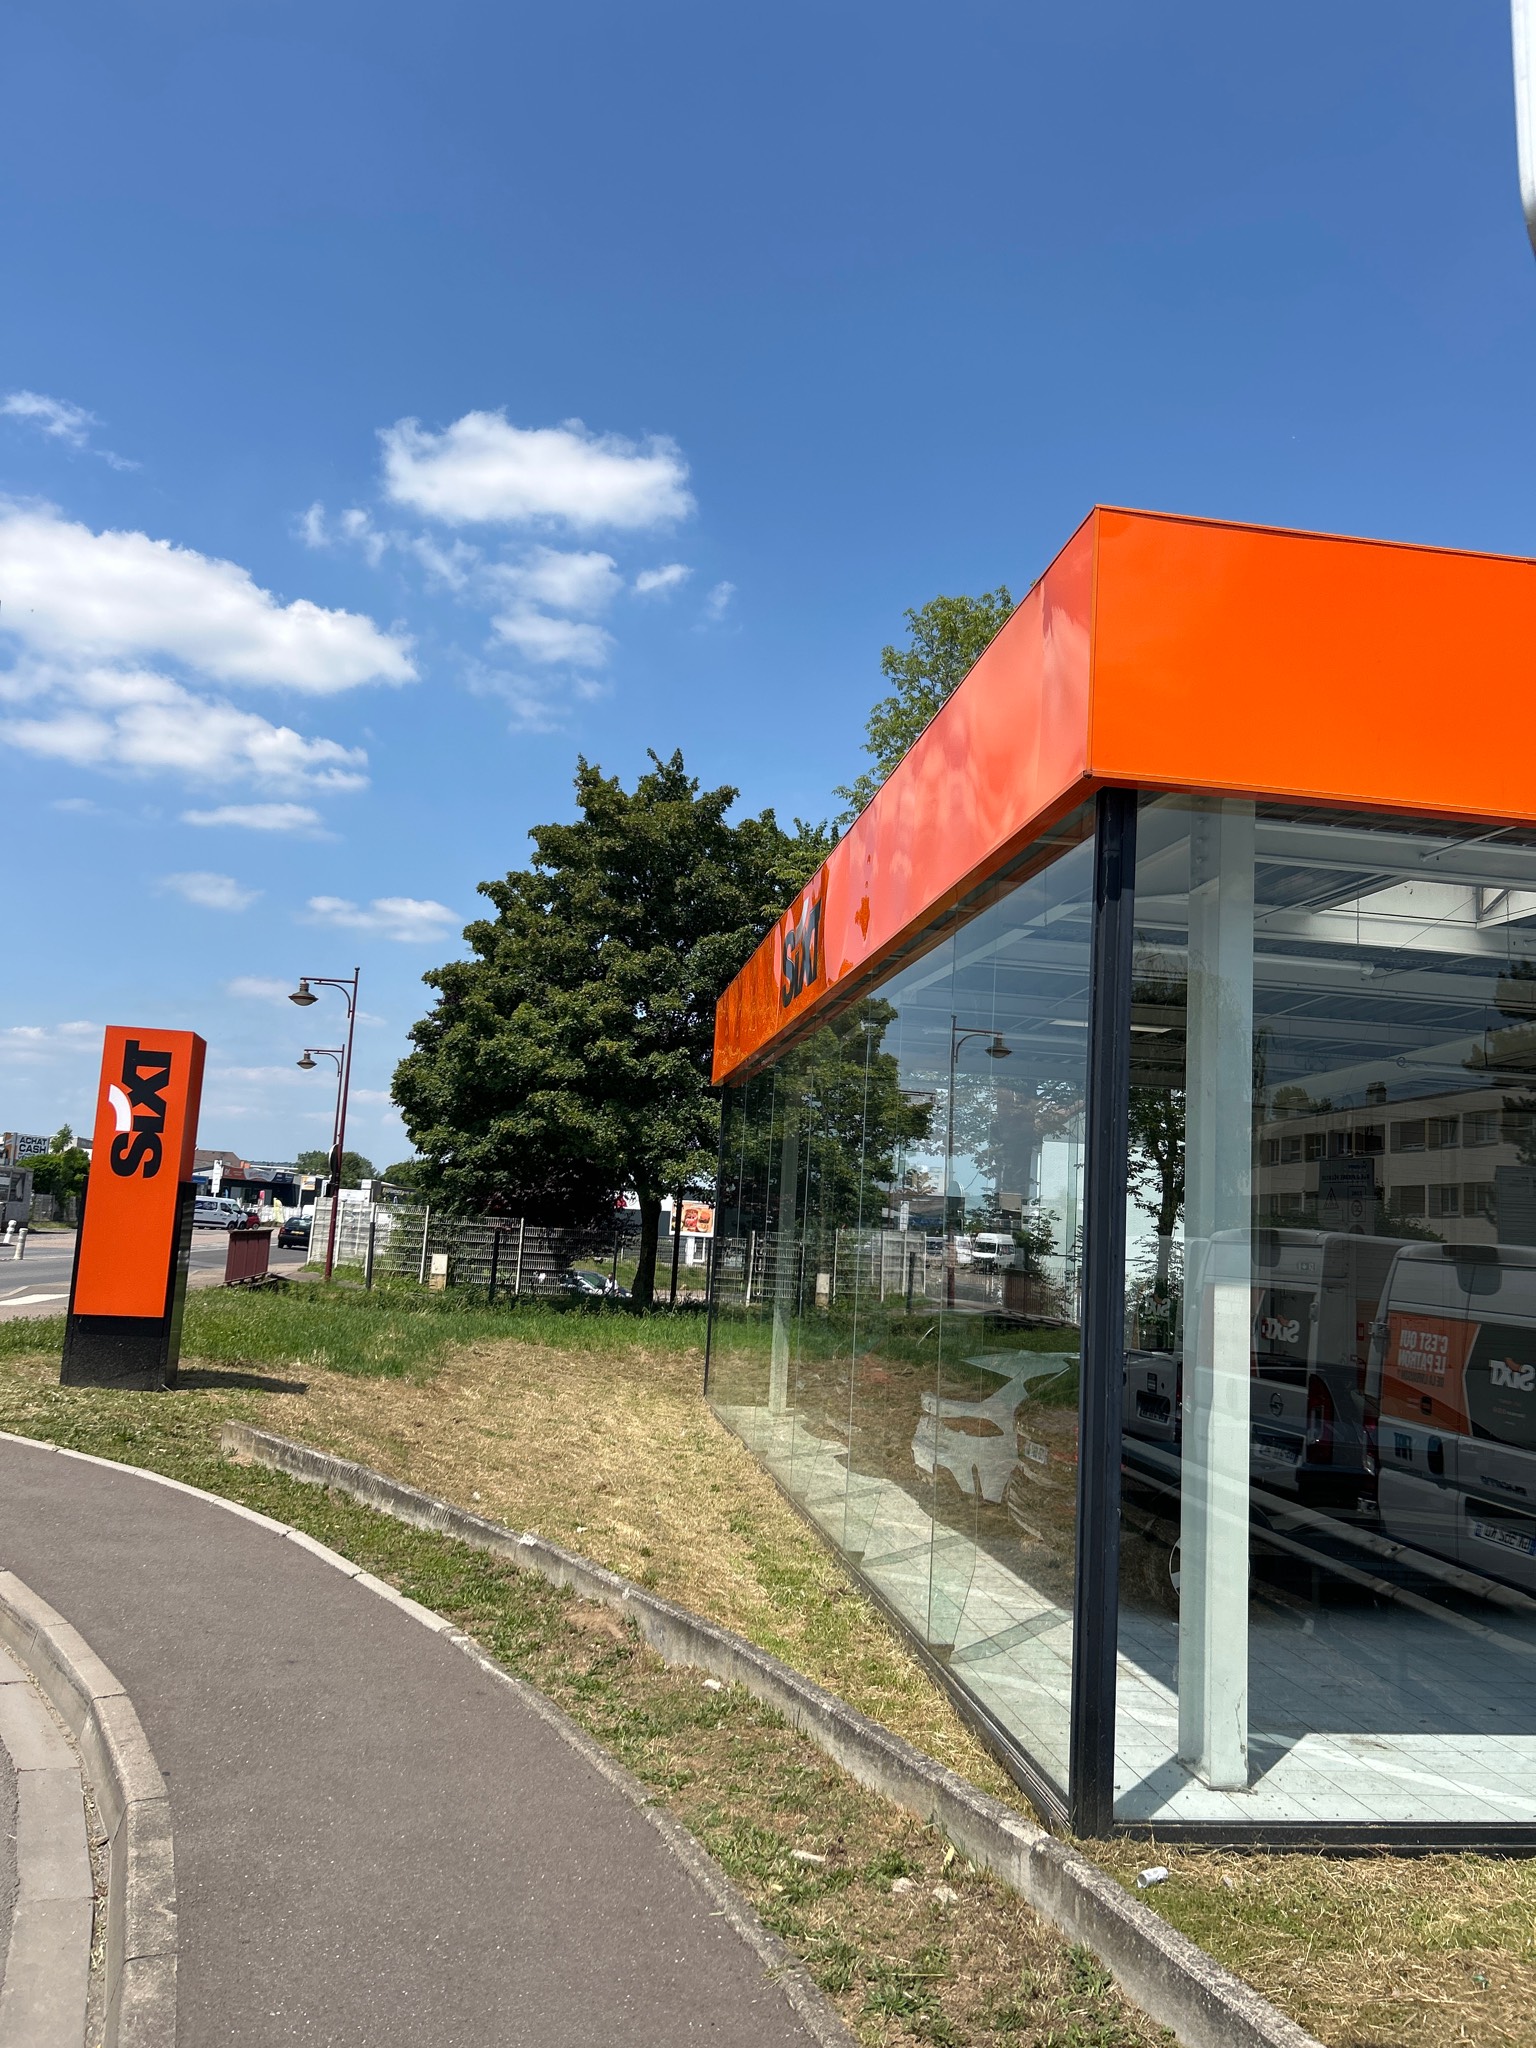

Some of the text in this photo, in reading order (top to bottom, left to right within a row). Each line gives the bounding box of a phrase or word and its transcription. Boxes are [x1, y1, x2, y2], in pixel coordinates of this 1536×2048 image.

[782, 897, 822, 1008] SIXT
[108, 1039, 172, 1178] SIXT
[19, 1144, 47, 1154] CASH
[20, 1136, 47, 1145] ACHAT
